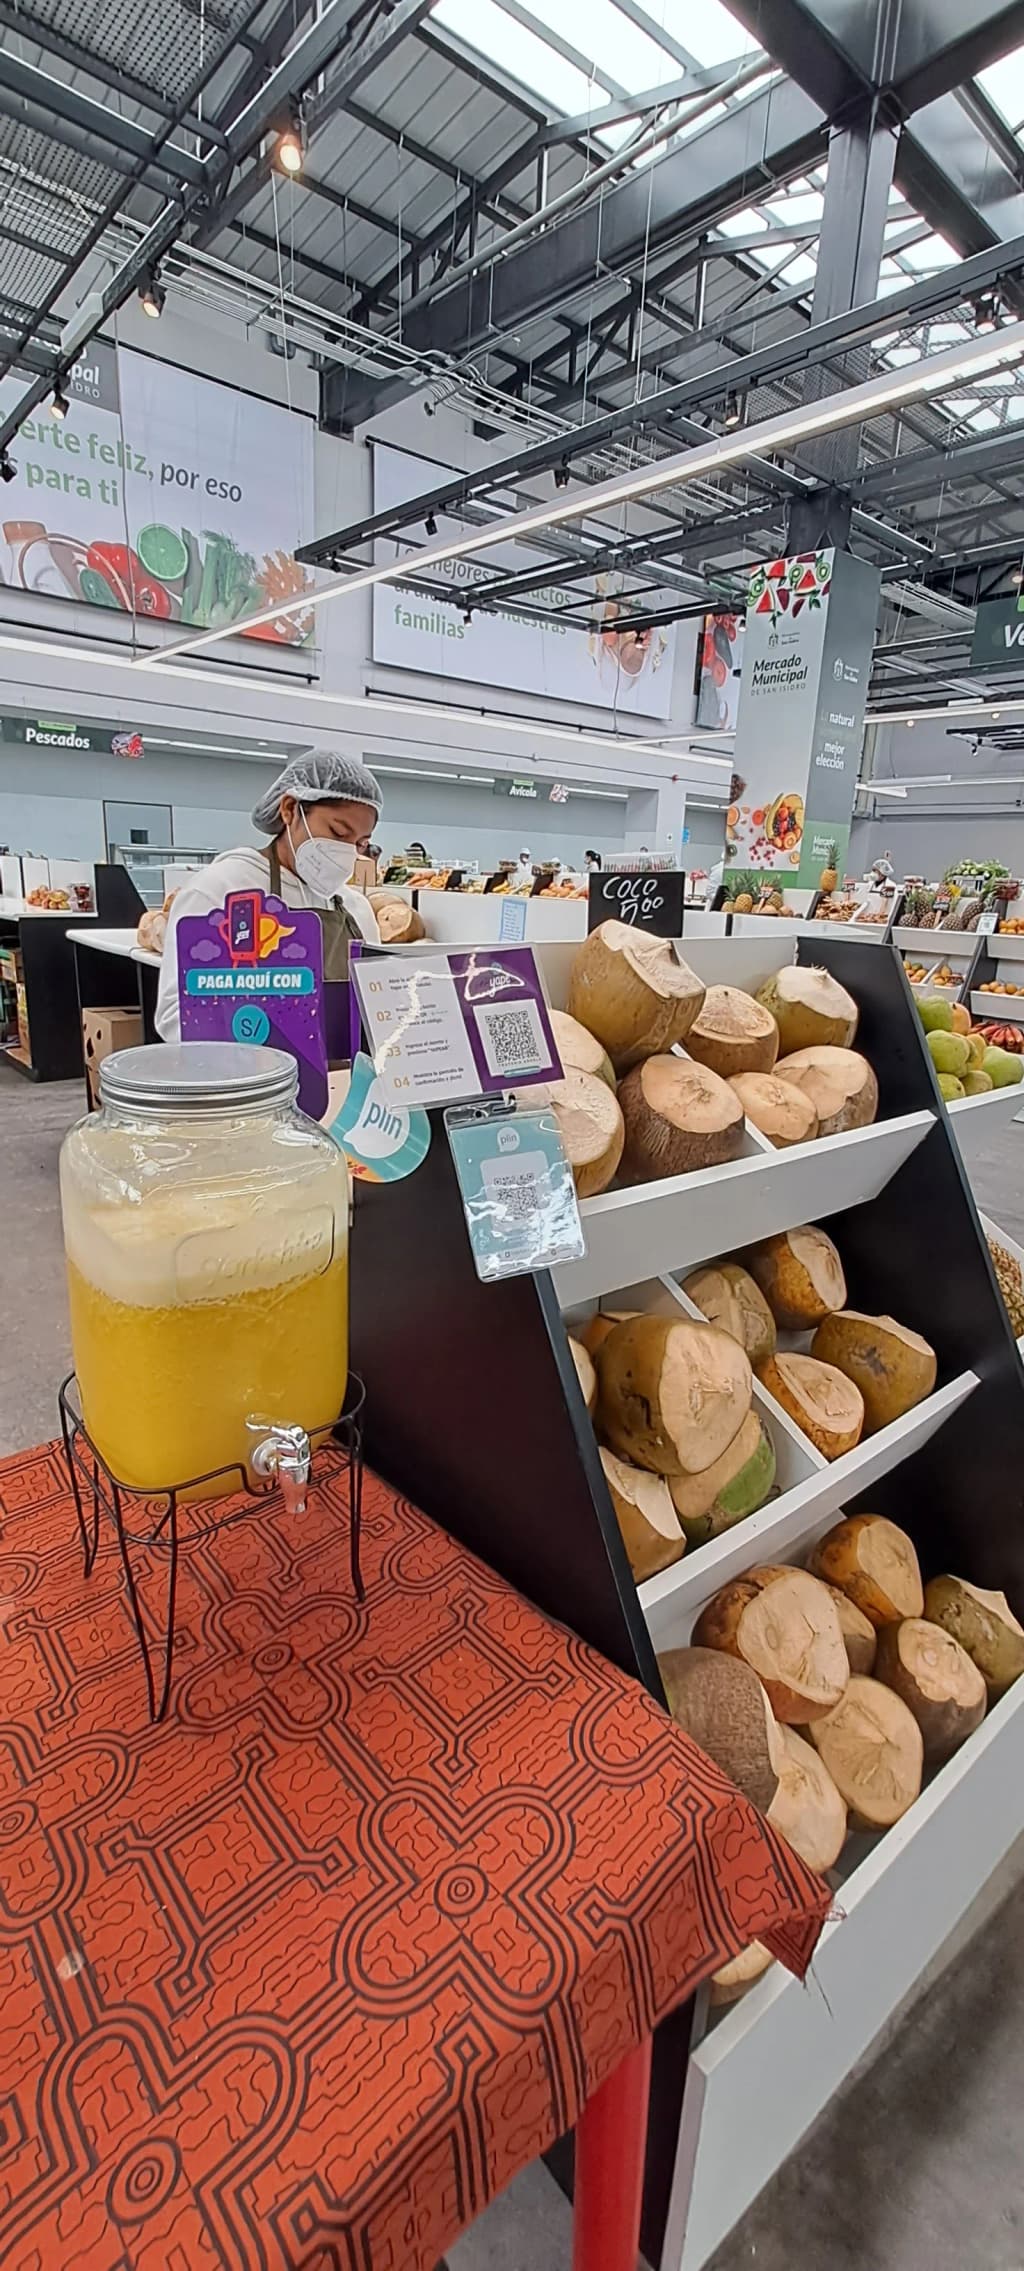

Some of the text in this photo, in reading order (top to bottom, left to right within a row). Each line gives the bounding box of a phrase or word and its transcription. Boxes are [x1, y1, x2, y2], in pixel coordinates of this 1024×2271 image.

[70, 381, 100, 398] IDRO
[20, 419, 242, 503] erte feliz, por eso
[26, 462, 92, 500] para
[98, 479, 119, 507] ti
[394, 604, 466, 640] familias
[753, 653, 802, 673] Mercado
[752, 665, 808, 687] Municipal
[750, 682, 806, 697] DE SAN ISIDRO
[829, 712, 855, 728] natural
[25, 727, 91, 749] Pescados
[824, 741, 845, 760] mejor
[815, 753, 845, 770] elección
[603, 876, 658, 899] COCO
[197, 971, 302, 990] PAGA AQUÍ CON
[369, 981, 383, 992] 01
[376, 1010, 392, 1022] 02
[240, 1017, 263, 1038] S/
[393, 1076, 411, 1089] 04
[362, 1102, 402, 1140] plin
[500, 1134, 518, 1146] plin
